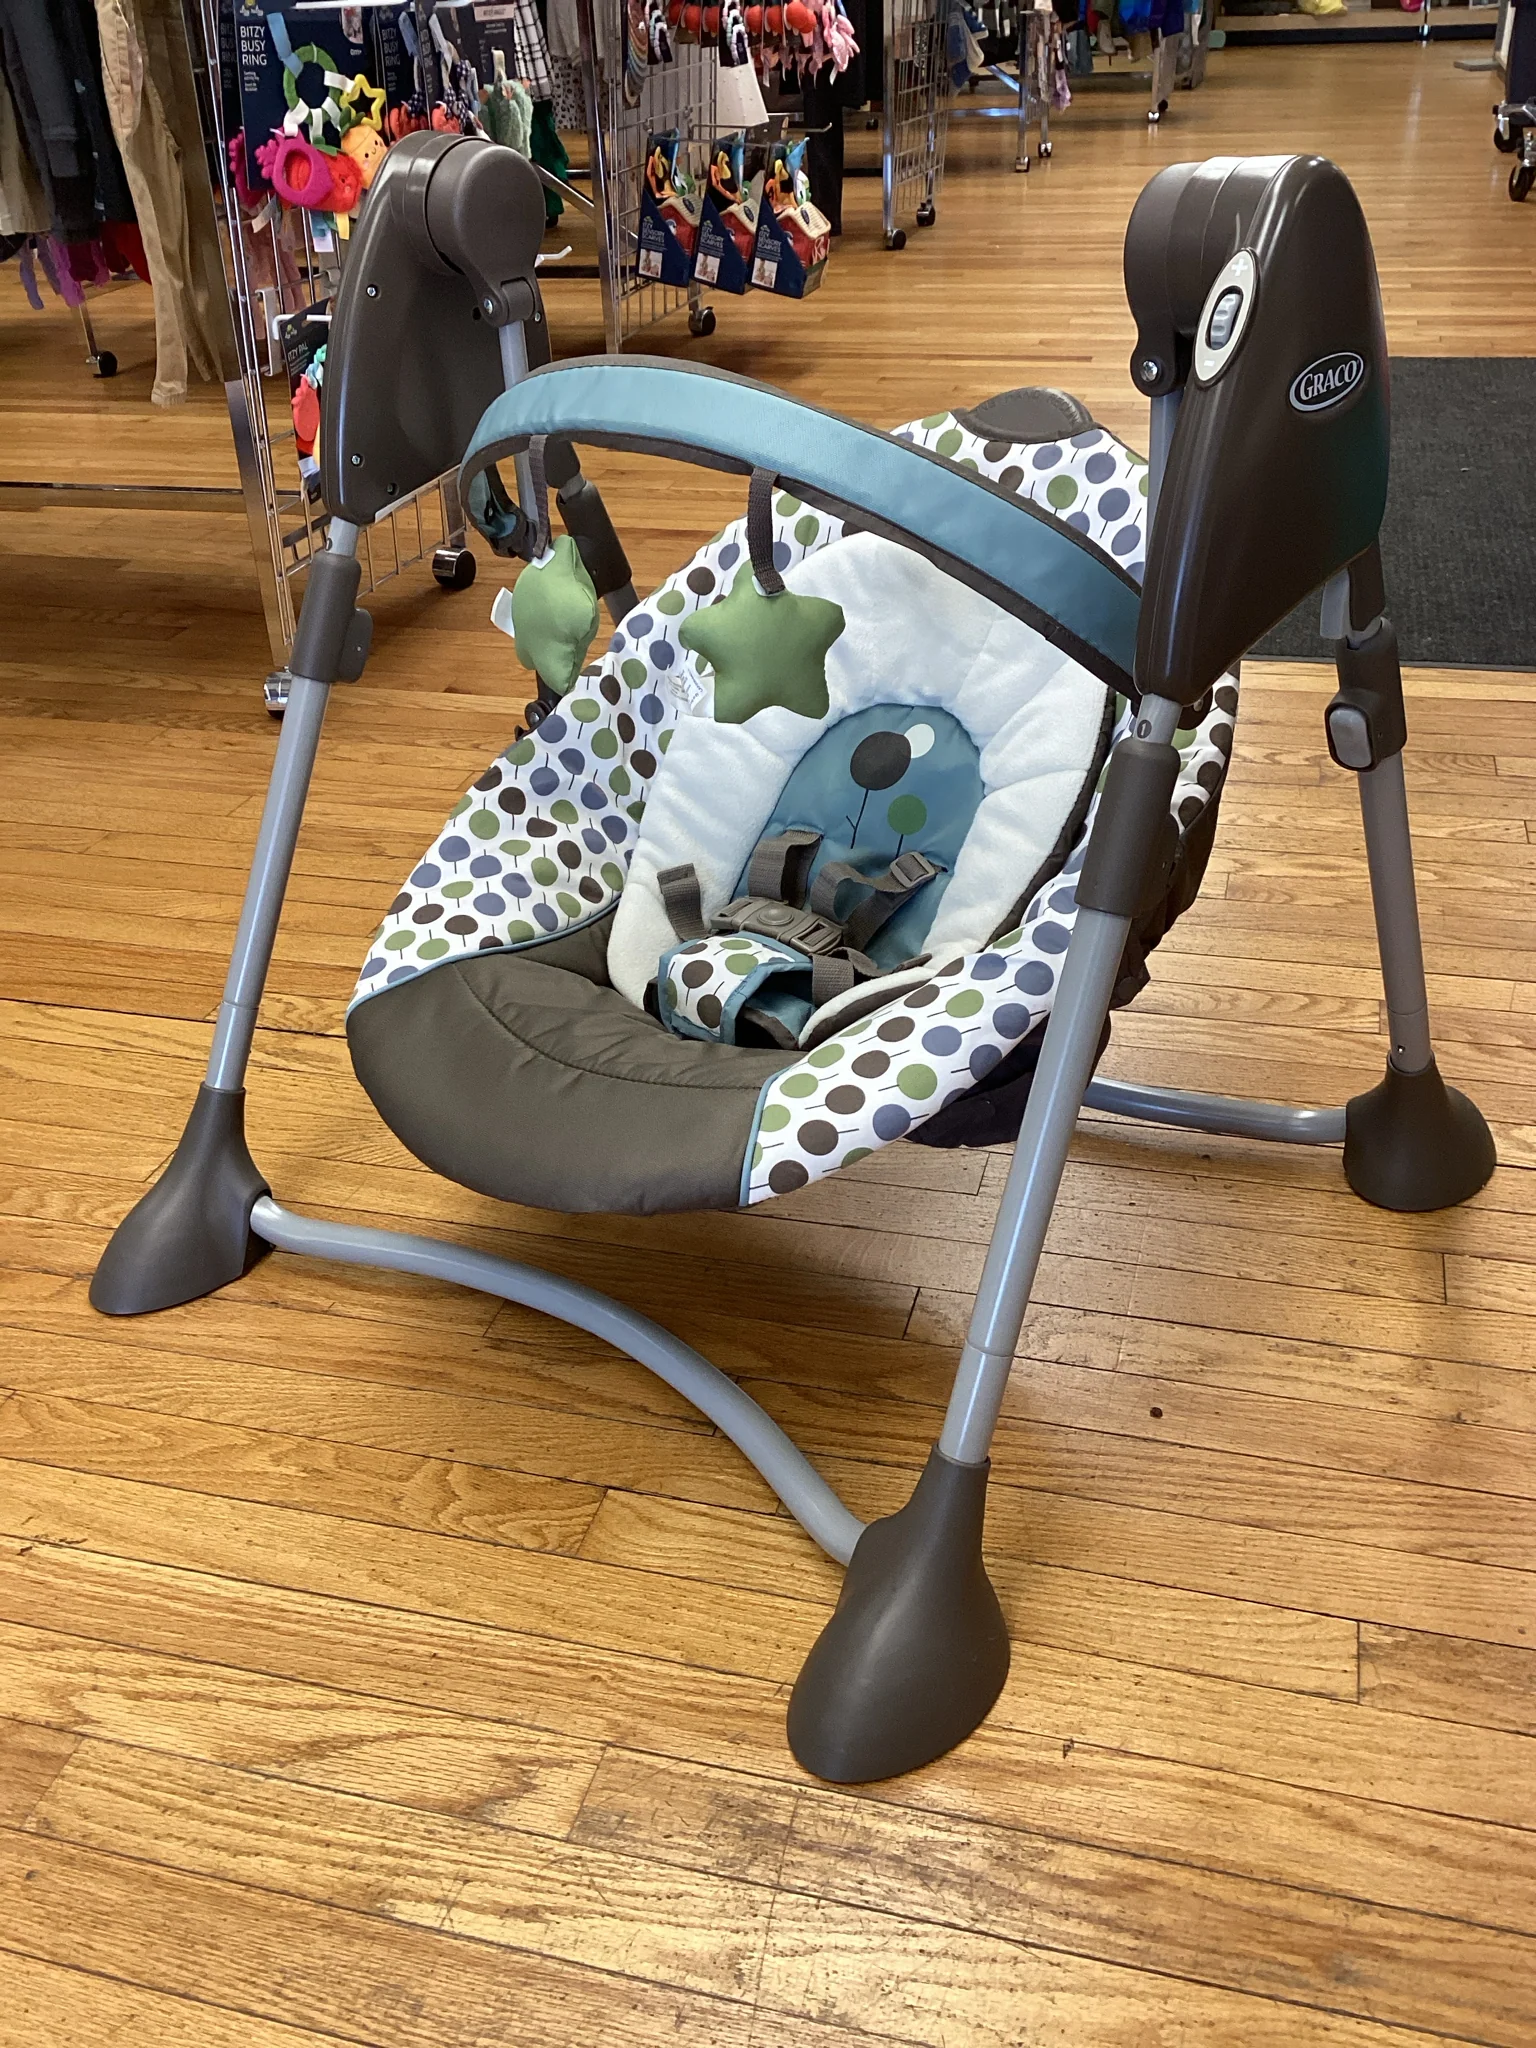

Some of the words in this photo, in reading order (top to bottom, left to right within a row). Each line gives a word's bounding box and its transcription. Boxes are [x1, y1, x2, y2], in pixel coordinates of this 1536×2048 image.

[240, 26, 265, 38] BITZY
[241, 40, 266, 52] BUSY
[242, 54, 267, 66] RING
[1300, 360, 1357, 400] GRACO
[1140, 722, 1147, 736] 1
